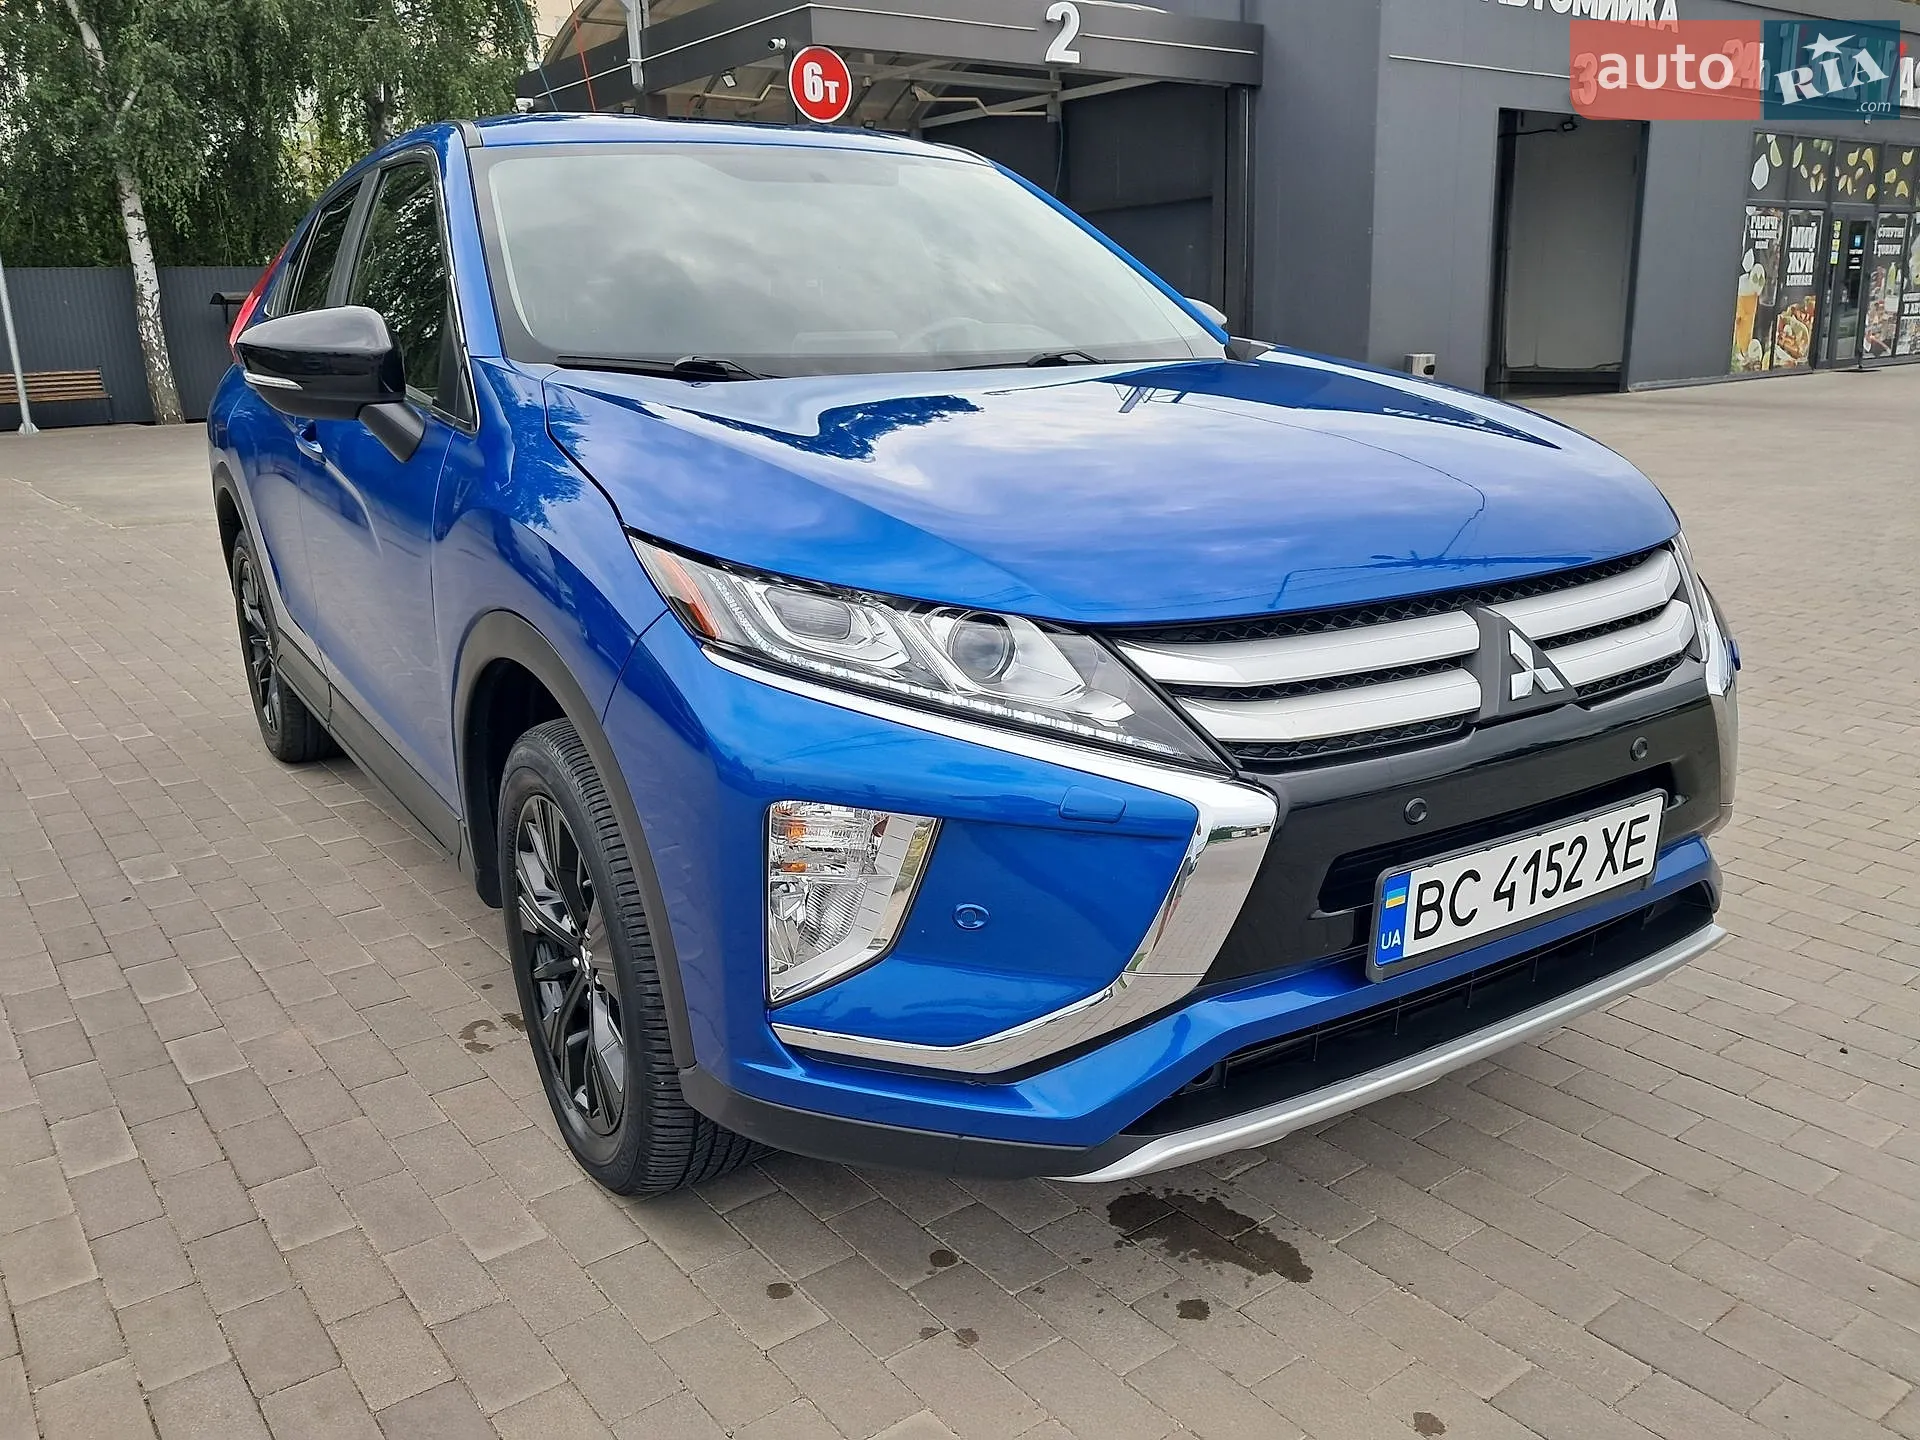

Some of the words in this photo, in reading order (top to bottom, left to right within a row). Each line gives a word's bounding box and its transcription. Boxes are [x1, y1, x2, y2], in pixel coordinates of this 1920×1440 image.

[1044, 1, 1081, 64] 2
[1790, 222, 1818, 249] МИЙ
[1412, 868, 1482, 941] BC
[1492, 835, 1588, 912] 4152
[1595, 813, 1651, 882] XE
[1381, 930, 1402, 951] UA
